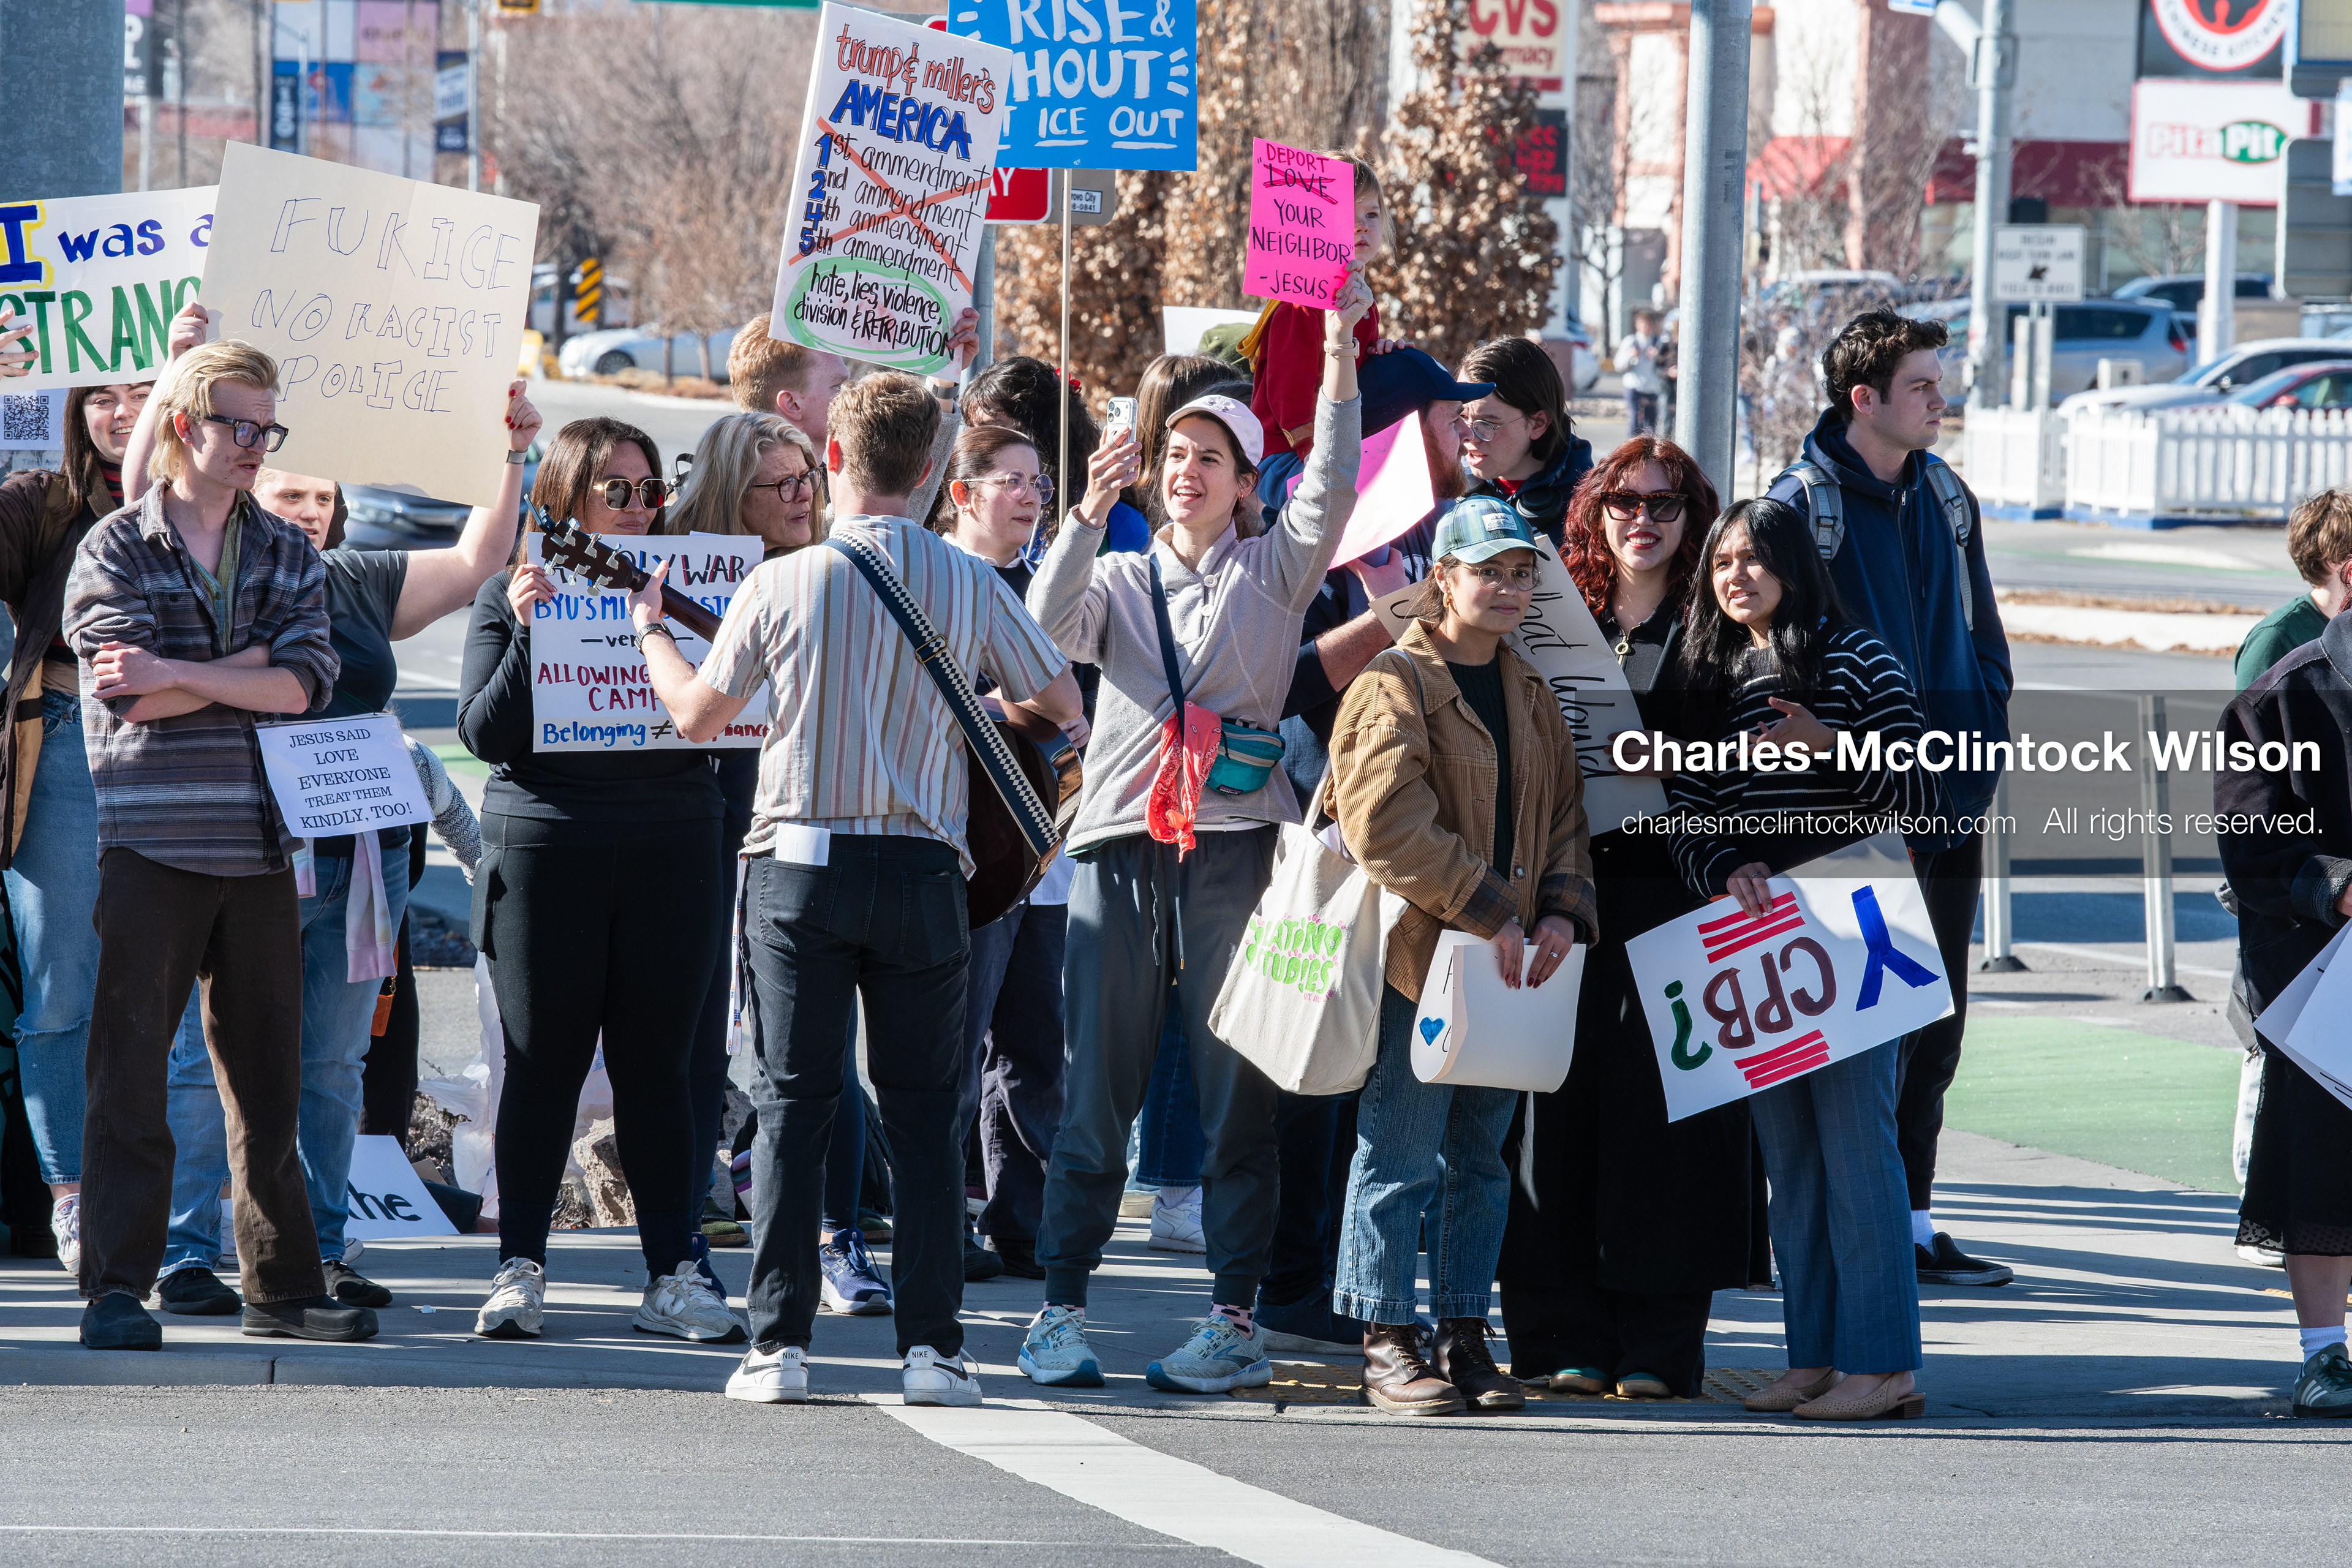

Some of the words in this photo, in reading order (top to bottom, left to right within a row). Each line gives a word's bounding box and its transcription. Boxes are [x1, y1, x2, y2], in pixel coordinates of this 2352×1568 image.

[1008, 0, 1145, 44] RISE
[1470, 0, 1558, 37] CVS
[837, 23, 903, 89] trump
[922, 56, 996, 114] miller's
[1012, 48, 1163, 102] HOUT
[829, 78, 972, 162] AMERICA
[1038, 107, 1088, 139] ICE
[1109, 106, 1184, 138] OUT
[815, 131, 858, 169] 1st
[861, 146, 991, 205] ammendment
[1266, 143, 1329, 173] DEPORT
[809, 167, 848, 201] 2nd
[855, 181, 981, 241] ammendment
[1085, 192, 1096, 204] City
[1273, 198, 1325, 228] YOUR
[0, 205, 43, 283] I
[58, 219, 165, 263] was
[799, 226, 832, 257] 5th
[804, 196, 840, 231] 4th
[850, 209, 969, 269] ammendment
[794, 292, 848, 330] division
[810, 263, 850, 303] hate,
[883, 283, 942, 325] violence,
[252, 289, 333, 342] NO
[345, 303, 501, 358] RACIST
[276, 355, 458, 413] POLICE
[681, 553, 745, 587] WAR
[535, 593, 594, 620] BYU'S
[290, 731, 334, 748] JESUS
[337, 728, 371, 742] SAID
[543, 720, 646, 747] Belonging
[314, 748, 359, 765] LOVE
[298, 767, 391, 790] EVERYONE
[304, 791, 351, 809] TREAT
[353, 786, 393, 799] THEM
[300, 808, 369, 829] KINDLY,
[371, 802, 413, 819] TOO!
[911, 1351, 929, 1359] NIKE
